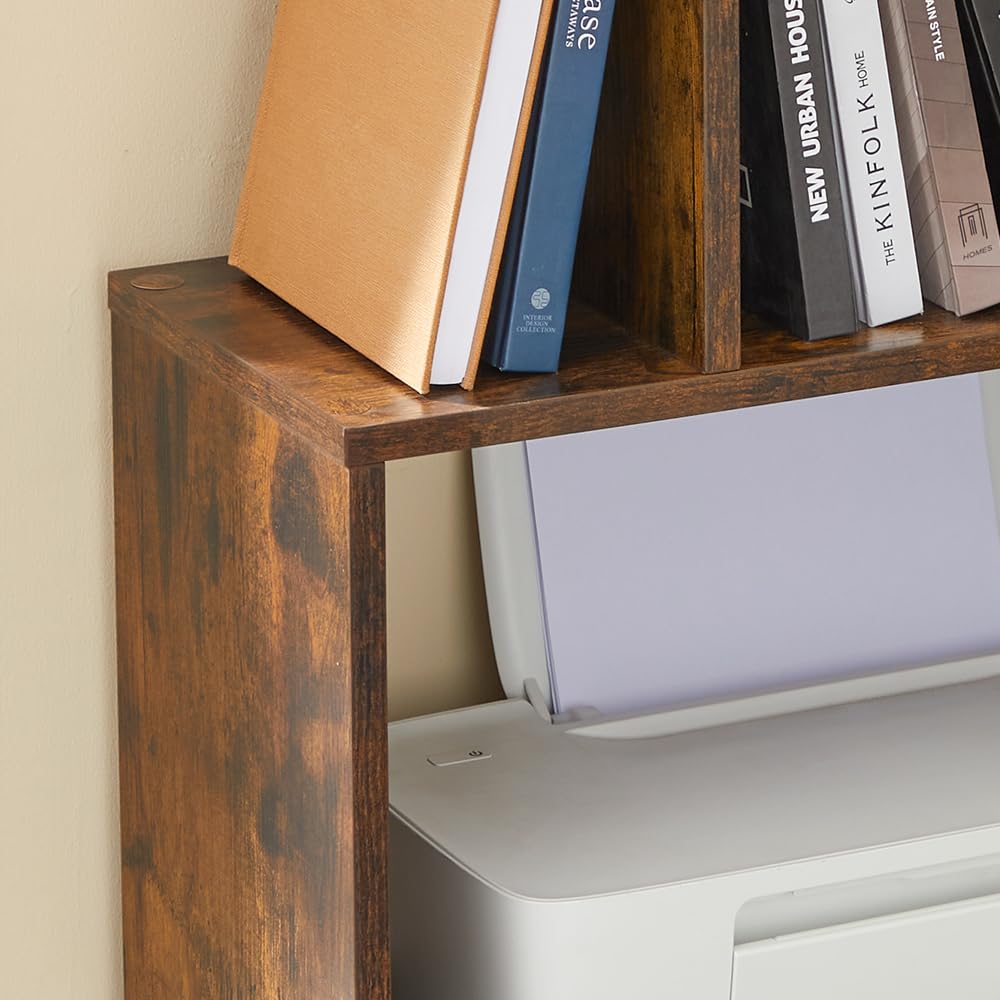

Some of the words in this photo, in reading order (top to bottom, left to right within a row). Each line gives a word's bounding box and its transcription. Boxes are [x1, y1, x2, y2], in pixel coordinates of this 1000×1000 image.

[565, 0, 581, 48] TAWAYS
[929, 21, 945, 62] STYLE
[854, 50, 869, 88] HOME
[794, 72, 822, 157] URBAN
[857, 93, 894, 232] KINFOLK
[805, 167, 830, 223] NEW
[883, 239, 896, 265] THE
[963, 244, 993, 260] HOMES
